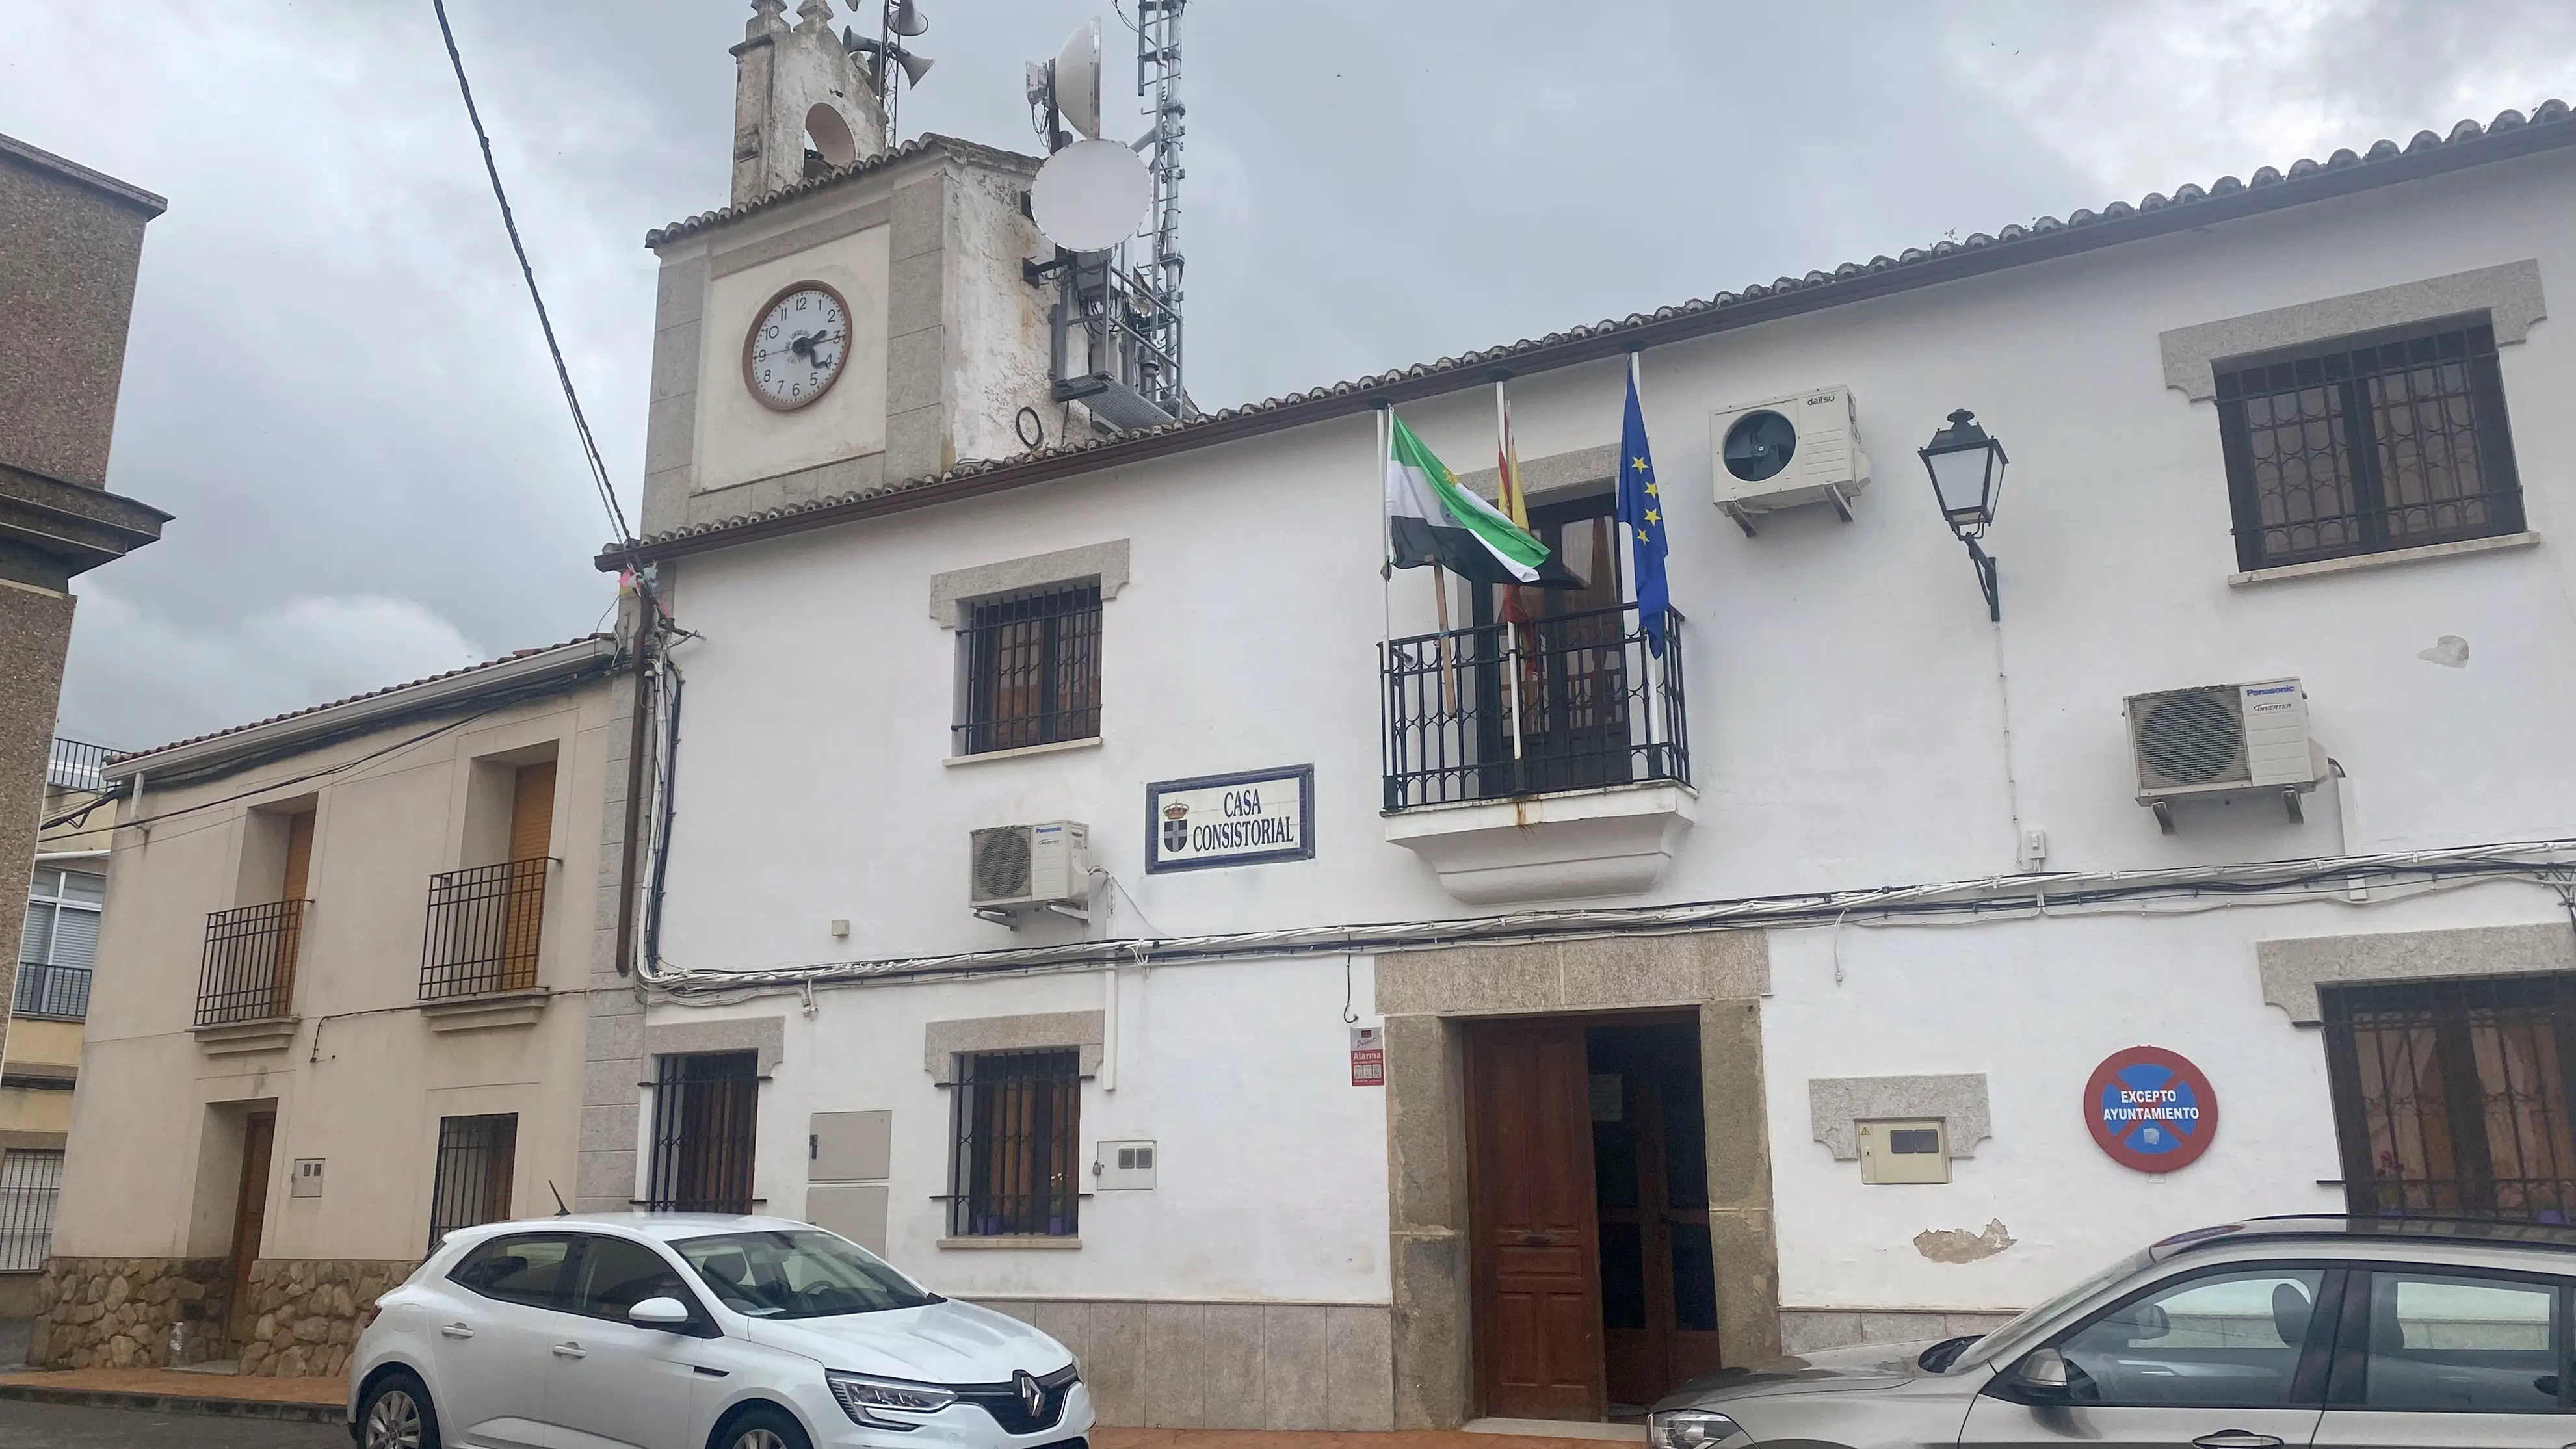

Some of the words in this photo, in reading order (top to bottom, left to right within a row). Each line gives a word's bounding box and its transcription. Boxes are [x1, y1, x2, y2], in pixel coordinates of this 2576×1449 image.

[796, 297, 807, 311] 12
[819, 300, 822, 311] 1
[780, 307, 787, 321] 11
[827, 309, 835, 323] 2
[765, 326, 780, 341] 10
[833, 331, 841, 344] 3
[759, 349, 767, 362] 9
[825, 354, 832, 367] 4
[763, 369, 770, 382] 8
[810, 372, 818, 385] 5
[777, 380, 785, 394] 7
[792, 384, 800, 396] 6
[2246, 685, 2294, 696] Panasonic
[2257, 703, 2292, 712] INVERTER
[1224, 788, 1261, 818] CASA
[1193, 816, 1294, 852] CONSISTORIAL
[1353, 1052, 1381, 1060] Alarma
[2120, 1090, 2177, 1103] EXCEPTO
[2103, 1106, 2200, 1121] AYUNTAMIENTO
